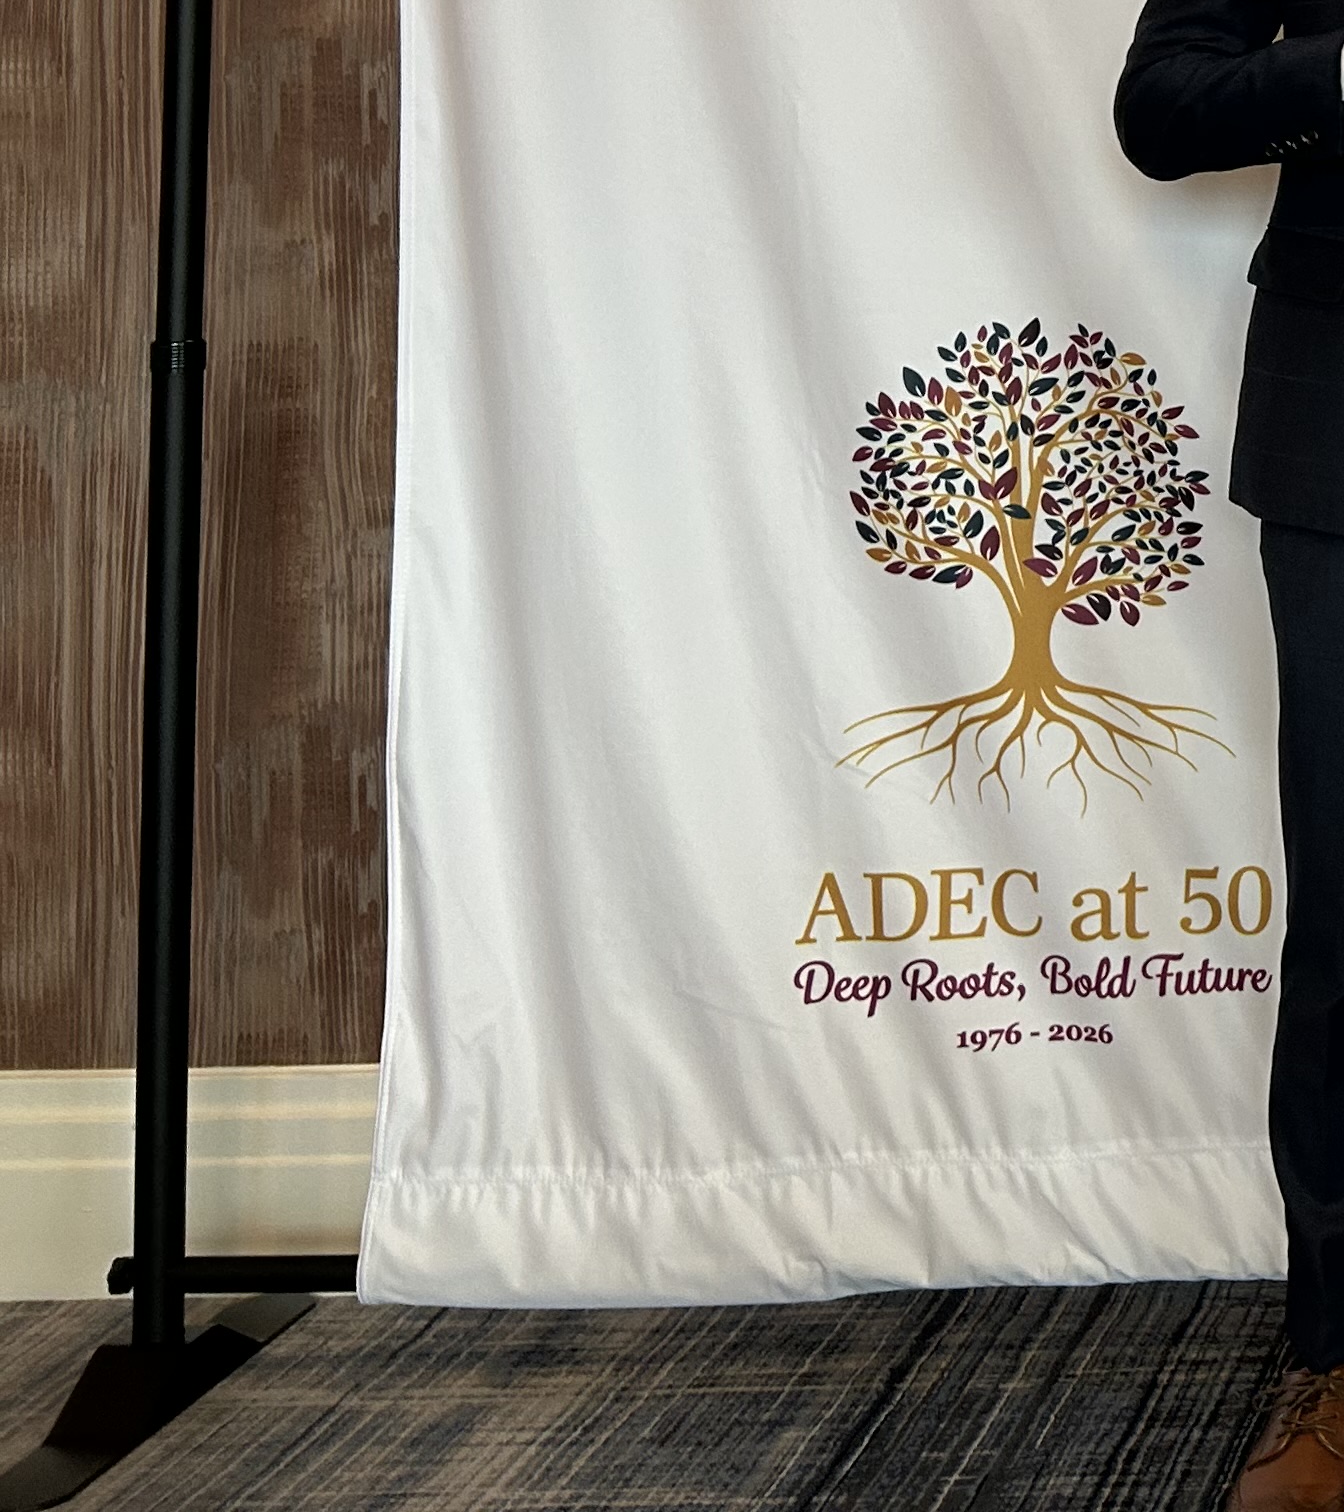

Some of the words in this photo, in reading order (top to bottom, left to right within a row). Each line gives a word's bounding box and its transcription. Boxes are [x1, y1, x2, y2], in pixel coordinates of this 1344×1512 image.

[795, 868, 1042, 945] ADEC
[1070, 872, 1149, 942] at
[1180, 866, 1272, 936] 50
[794, 961, 892, 1018] Deep
[901, 959, 1026, 1003] Roots,
[1040, 955, 1137, 999] Bold
[1141, 953, 1273, 997] Future
[957, 1022, 1022, 1053] 1976
[1048, 1024, 1113, 1044] 2026
